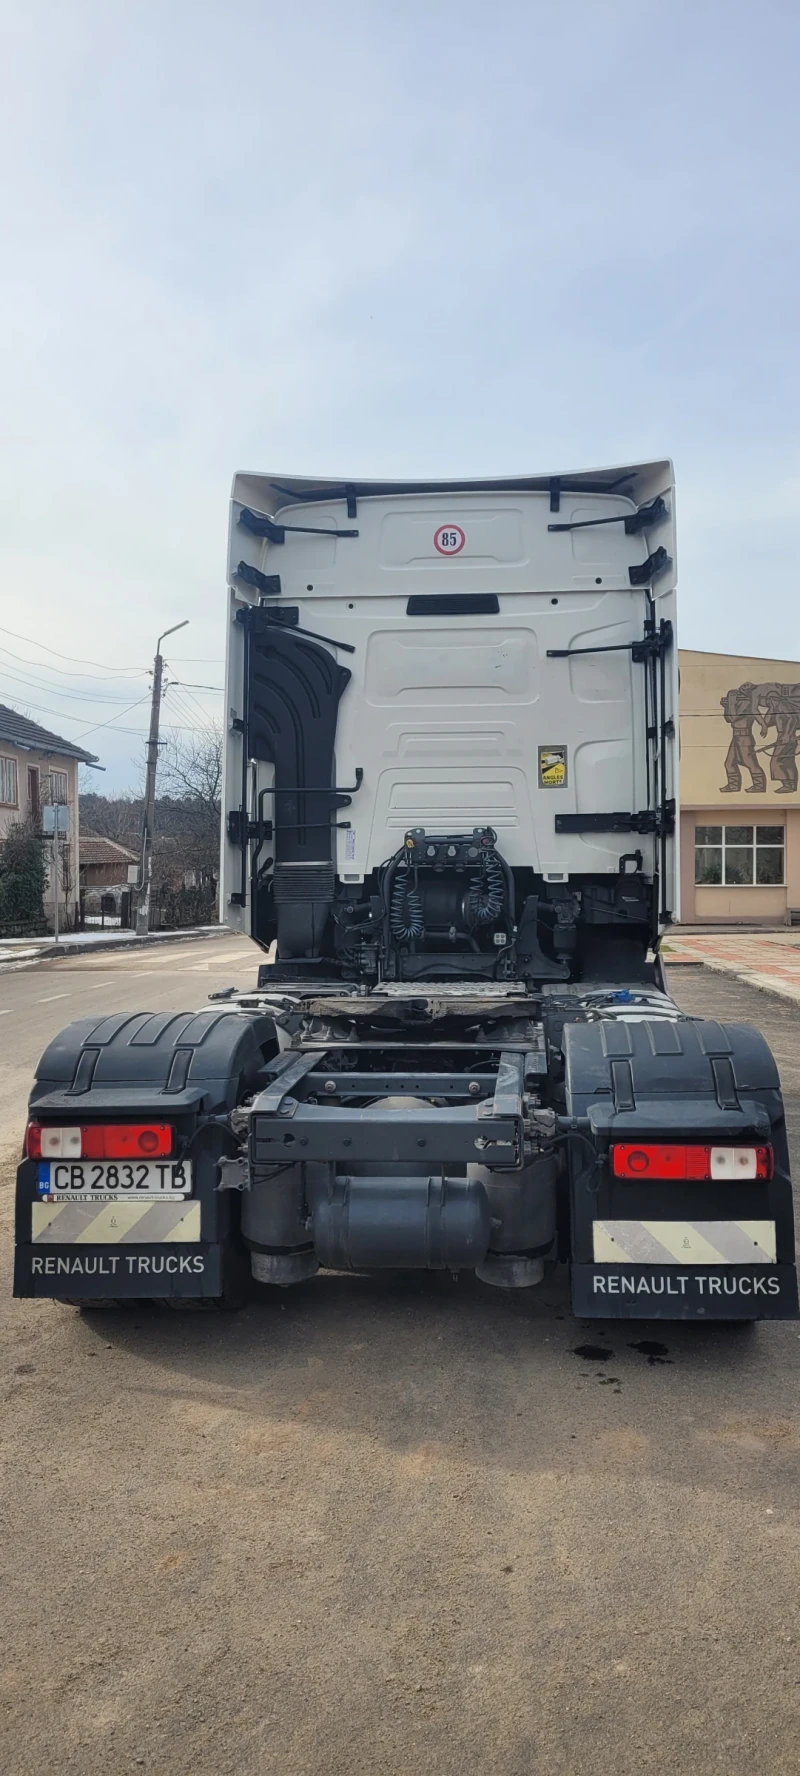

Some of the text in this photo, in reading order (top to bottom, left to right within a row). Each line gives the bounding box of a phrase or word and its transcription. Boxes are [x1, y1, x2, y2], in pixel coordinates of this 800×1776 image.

[442, 532, 457, 547] 85
[54, 1164, 186, 1189] CB 2832 TB
[31, 1256, 205, 1274] RENAULT TRUCKS
[593, 1276, 781, 1295] RENAULT TRUCKS
